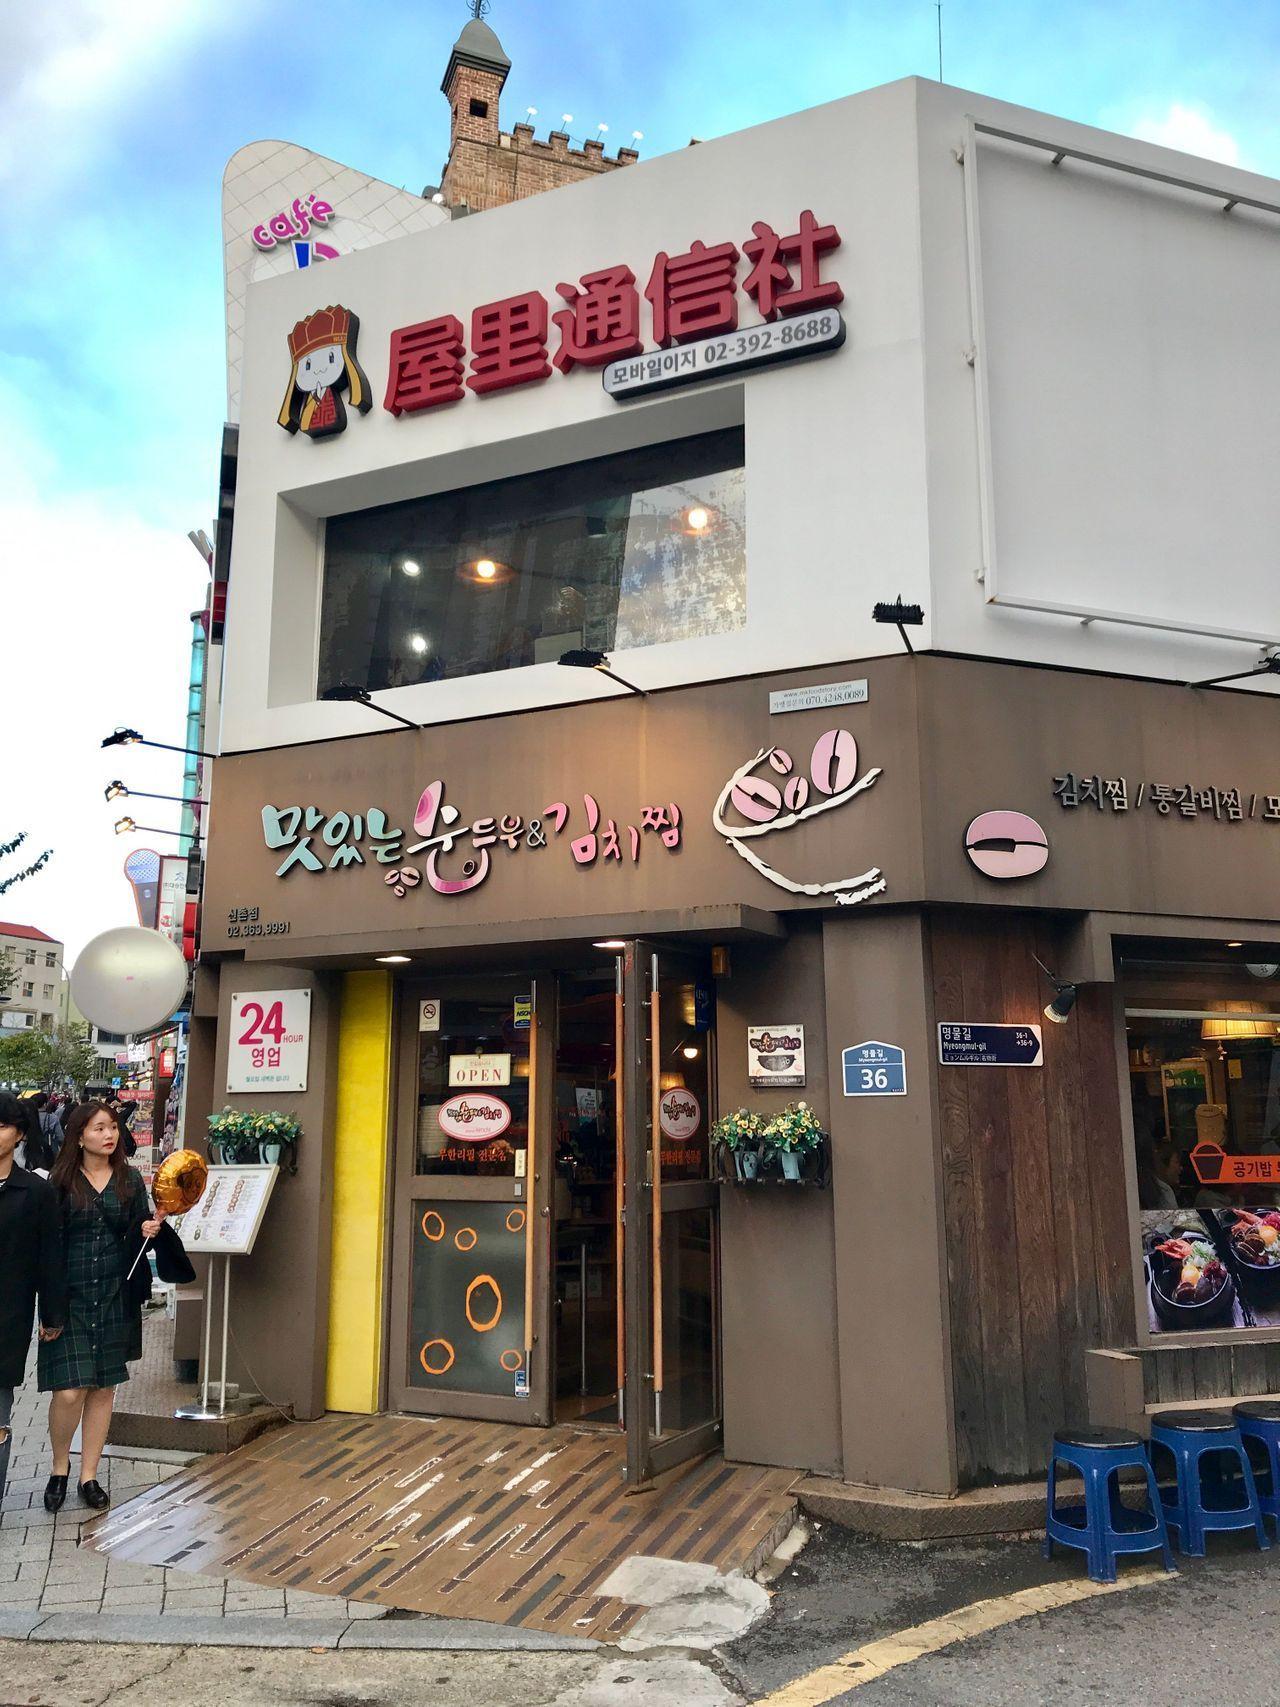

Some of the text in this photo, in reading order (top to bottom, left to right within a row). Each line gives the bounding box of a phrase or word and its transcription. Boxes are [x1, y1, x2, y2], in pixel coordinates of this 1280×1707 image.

[384, 209, 845, 417] 屋里通信社
[612, 316, 832, 386] 모바일이지 02-392-8688
[1053, 772, 1129, 811] 김치찜
[1151, 782, 1244, 821] 통갈비찜
[261, 804, 403, 878] 맛있는
[227, 906, 260, 923] 신촌점
[239, 1001, 304, 1046] 24 HOUR
[942, 1027, 972, 1041] 명물길
[251, 1047, 281, 1068] 영업
[456, 1068, 502, 1082] OPEN
[861, 1068, 888, 1089] 36
[1233, 1161, 1272, 1178] 공기밥
